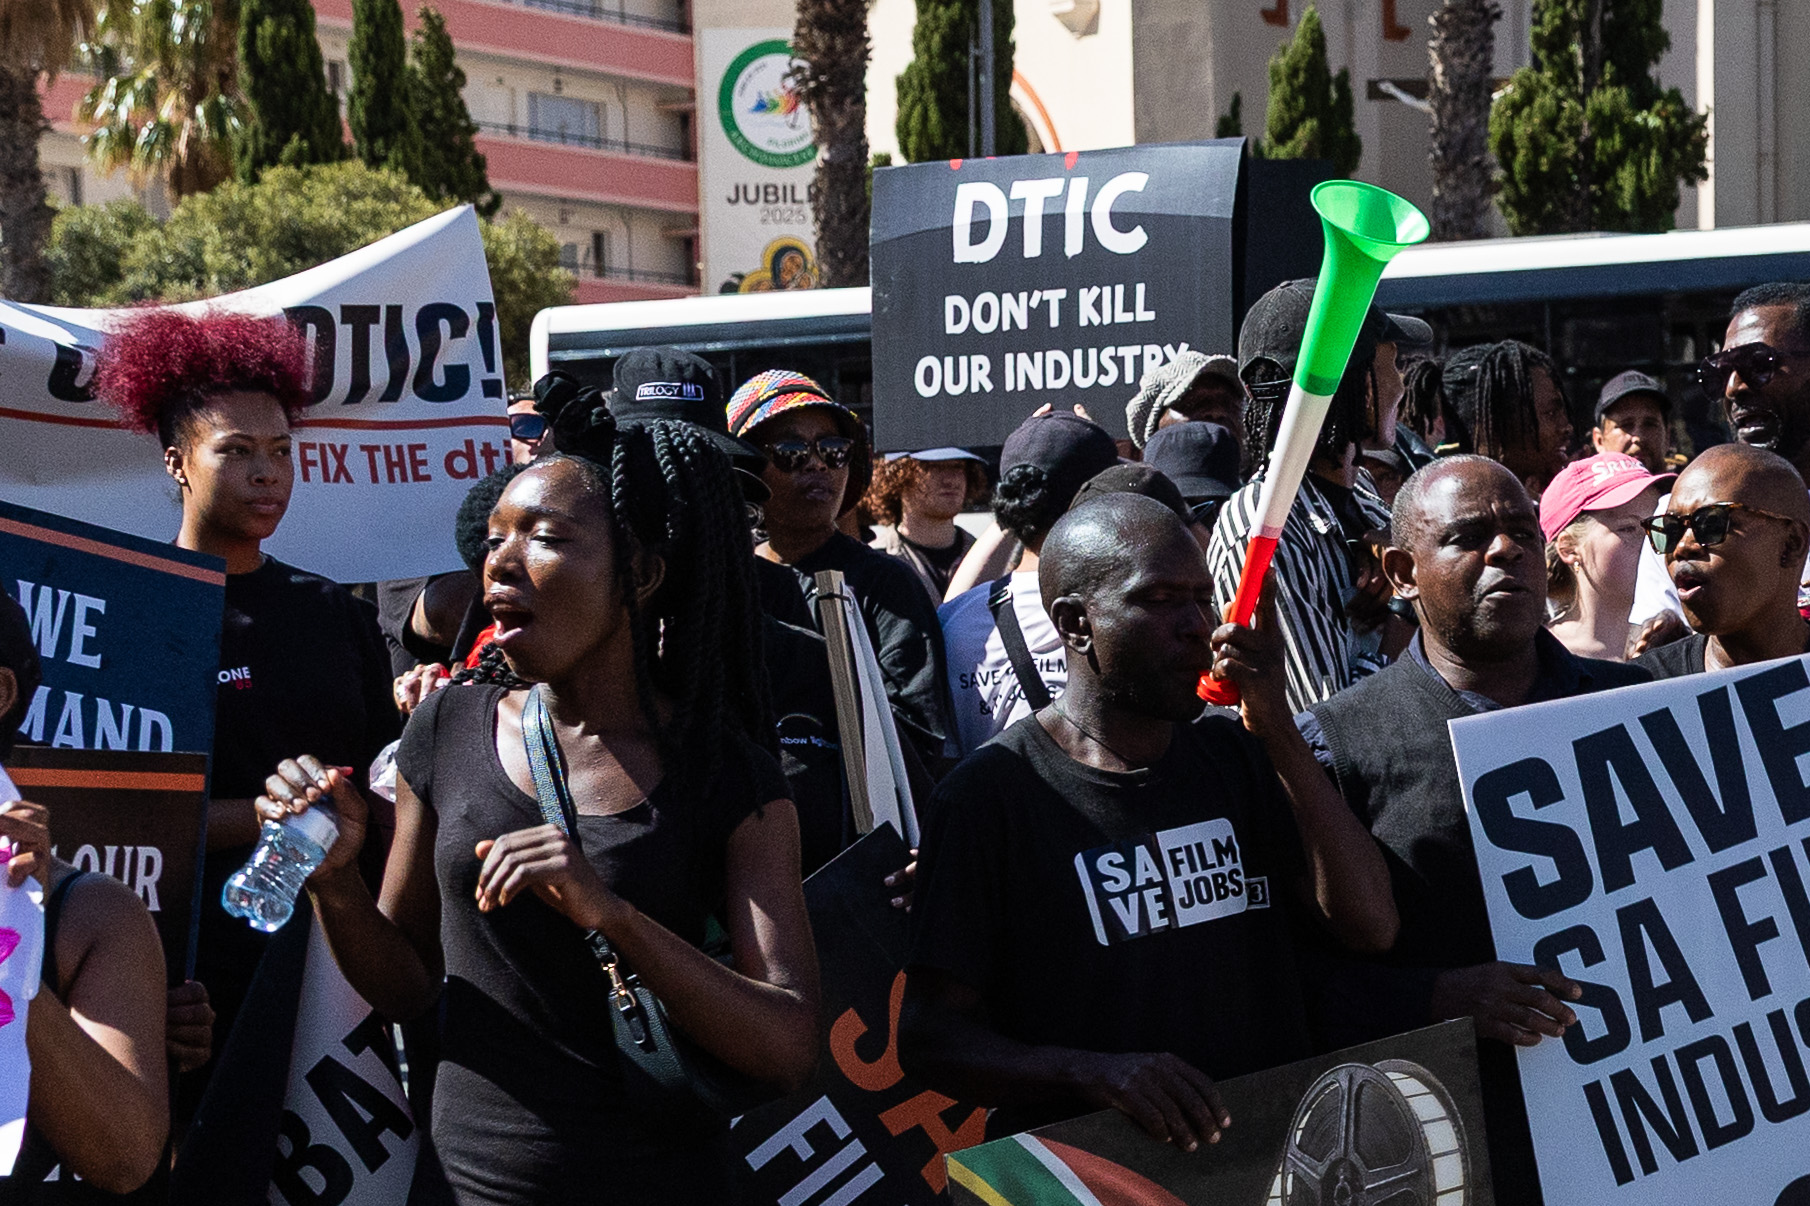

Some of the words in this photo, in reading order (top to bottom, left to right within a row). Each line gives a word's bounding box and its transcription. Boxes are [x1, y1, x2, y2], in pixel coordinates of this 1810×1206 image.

[726, 182, 815, 206] JUBIL
[952, 171, 1150, 265] DTIC
[944, 287, 1067, 336] DON'T
[1078, 282, 1156, 328] KILL
[914, 354, 994, 398] OUR
[300, 442, 355, 484] FIX
[360, 443, 431, 484] THE
[443, 438, 513, 480] dti
[16, 579, 106, 669] WE
[959, 669, 1002, 690] SAVE
[1096, 844, 1163, 893] SA
[1167, 835, 1239, 878] FILM
[1108, 887, 1169, 935] VE
[1178, 867, 1244, 910] JOBS
[1532, 895, 1715, 1066] SA
